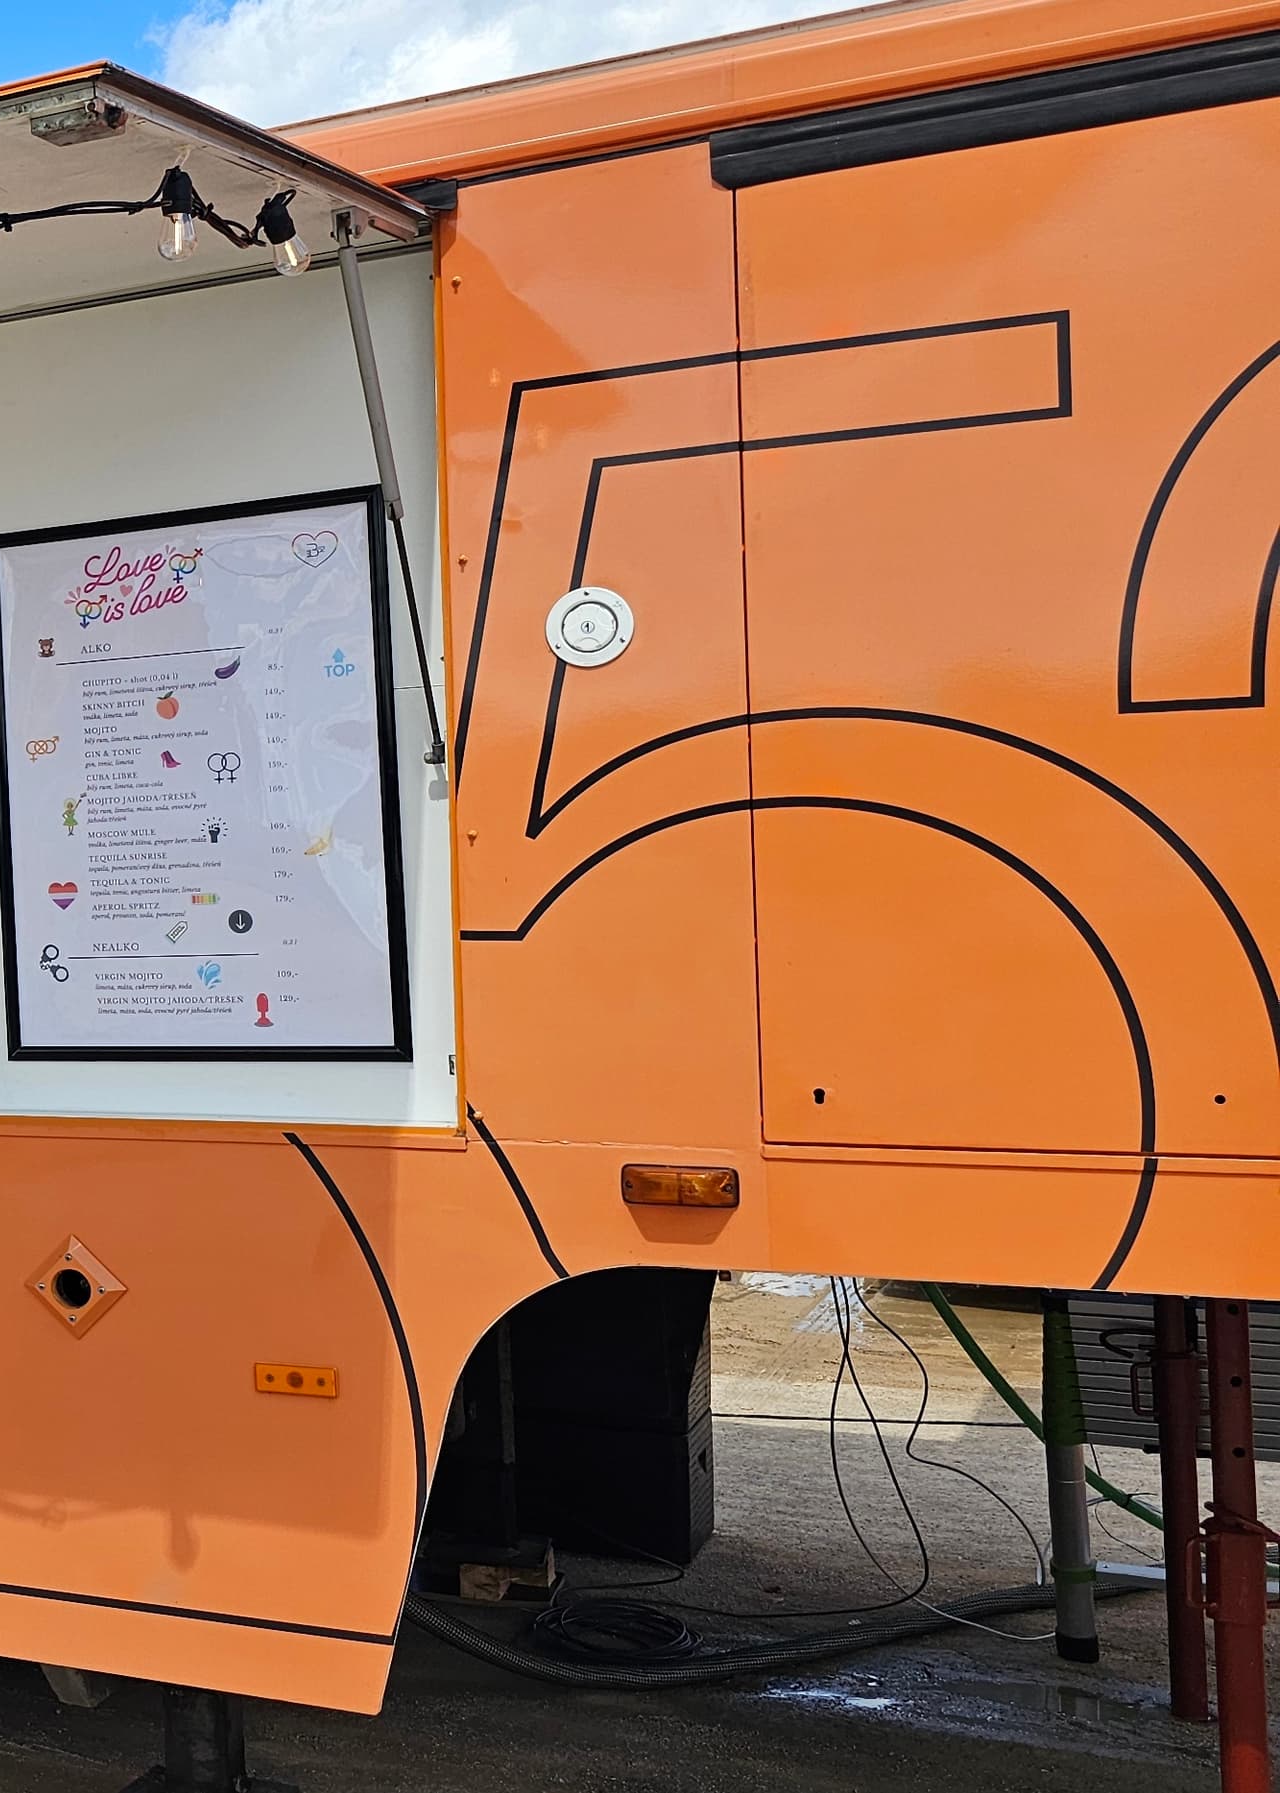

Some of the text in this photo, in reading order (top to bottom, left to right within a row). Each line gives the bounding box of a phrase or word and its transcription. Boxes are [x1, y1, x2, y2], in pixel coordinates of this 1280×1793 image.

[83, 546, 166, 593] Love
[103, 574, 188, 623] is love
[81, 643, 111, 654] ALKO
[324, 664, 355, 677] TOP
[82, 677, 122, 688] CHUPITO
[82, 699, 145, 711] SKINNY BITCH
[84, 726, 118, 736] MOJITO
[84, 748, 142, 759] GIN & TONIC
[86, 772, 138, 782] CUBA LIBRE
[87, 797, 121, 806] MOJITO
[88, 829, 156, 839] MOSCOW MULE
[88, 852, 168, 863] TEQUILA SUNRISE
[90, 876, 170, 888] TEQUILA & TONIC
[92, 902, 160, 912] APEROL SPRITZ
[93, 942, 139, 952] NEALKO
[95, 972, 163, 982] VIRGIN MOJITO
[97, 997, 128, 1005] VIRGIN
[131, 996, 166, 1005] MOJITO
